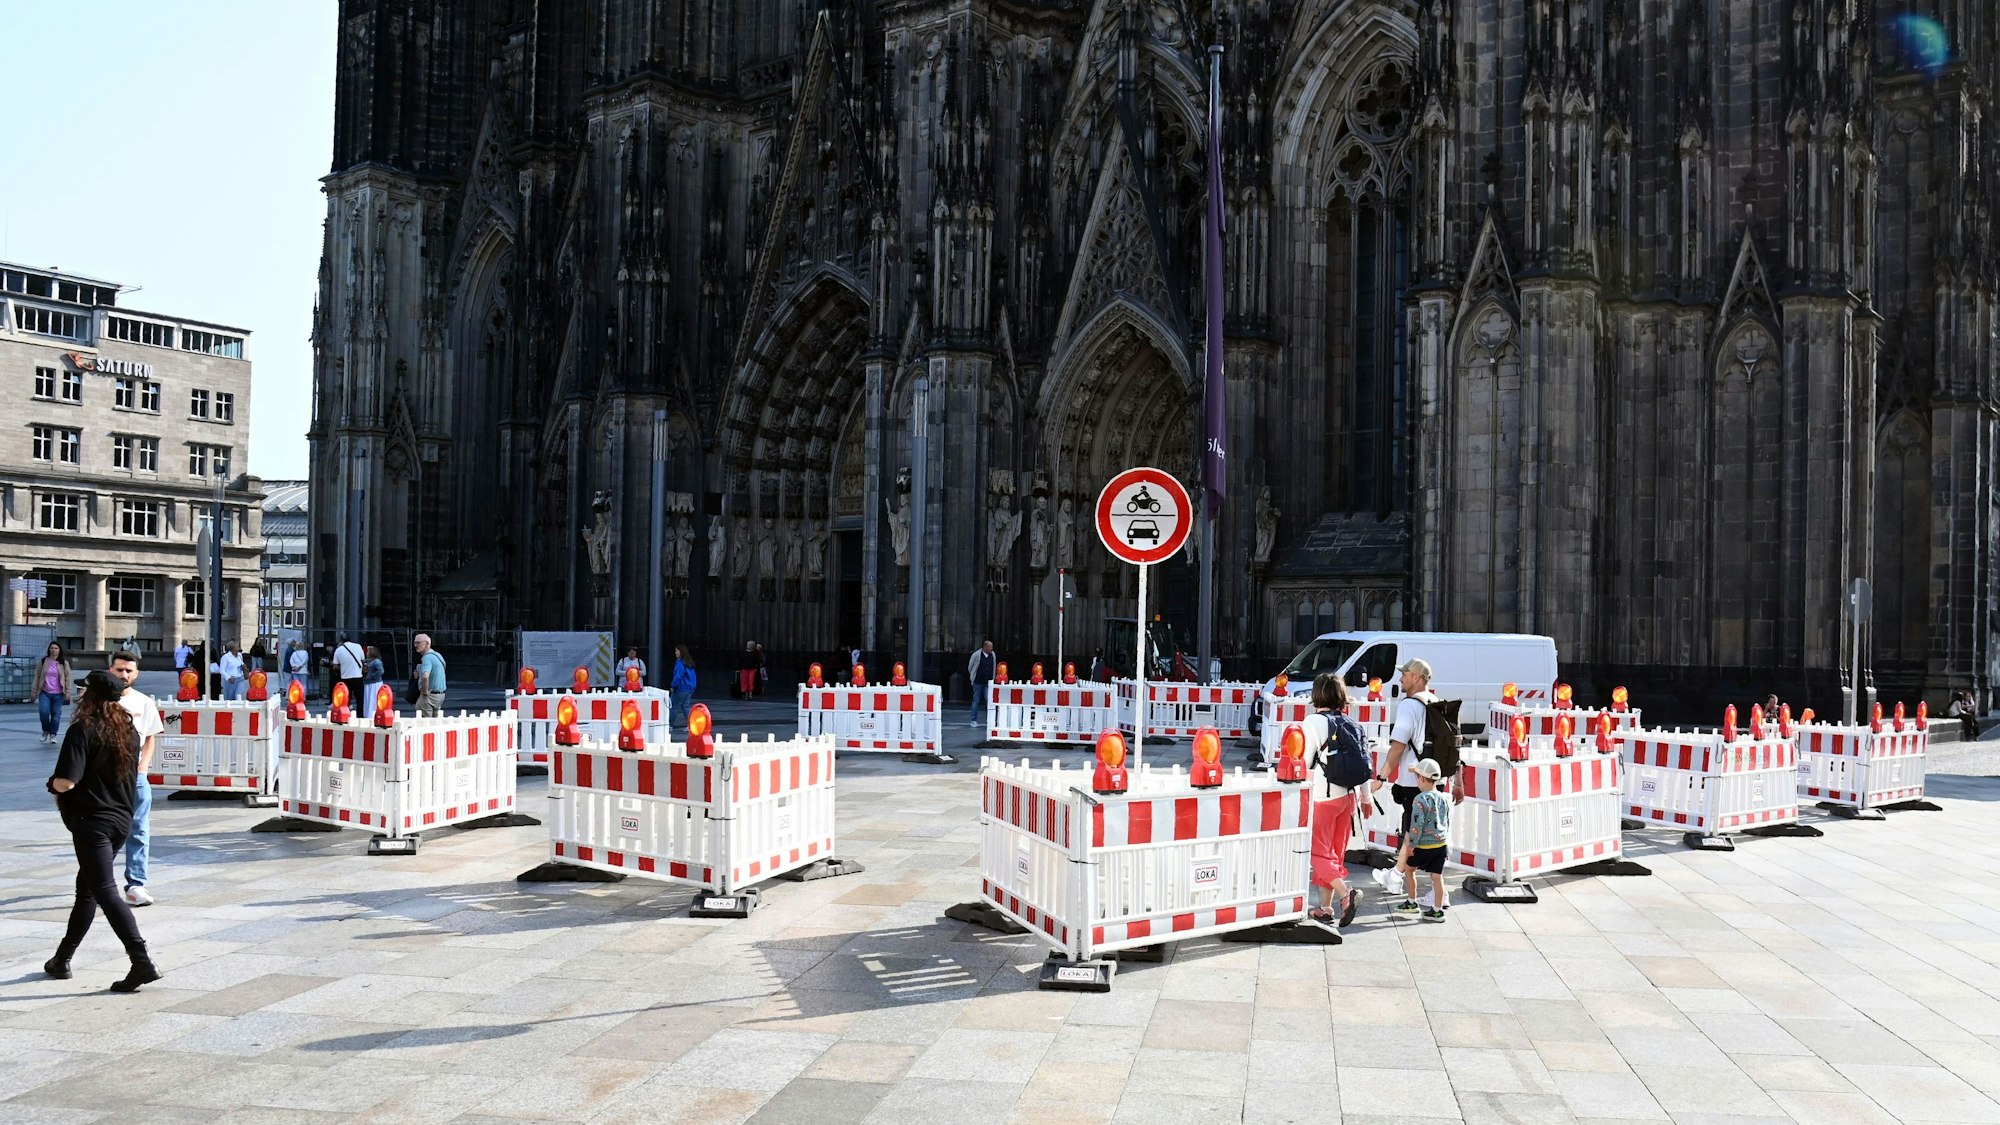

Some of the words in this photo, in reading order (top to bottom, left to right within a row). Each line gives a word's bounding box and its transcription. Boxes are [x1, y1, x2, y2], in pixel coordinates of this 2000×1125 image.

[96, 357, 153, 378] SATURN
[330, 778, 341, 786] LOKA
[1643, 782, 1654, 790] LOKA
[622, 820, 637, 828] LOKA
[1196, 869, 1216, 880] LOKA
